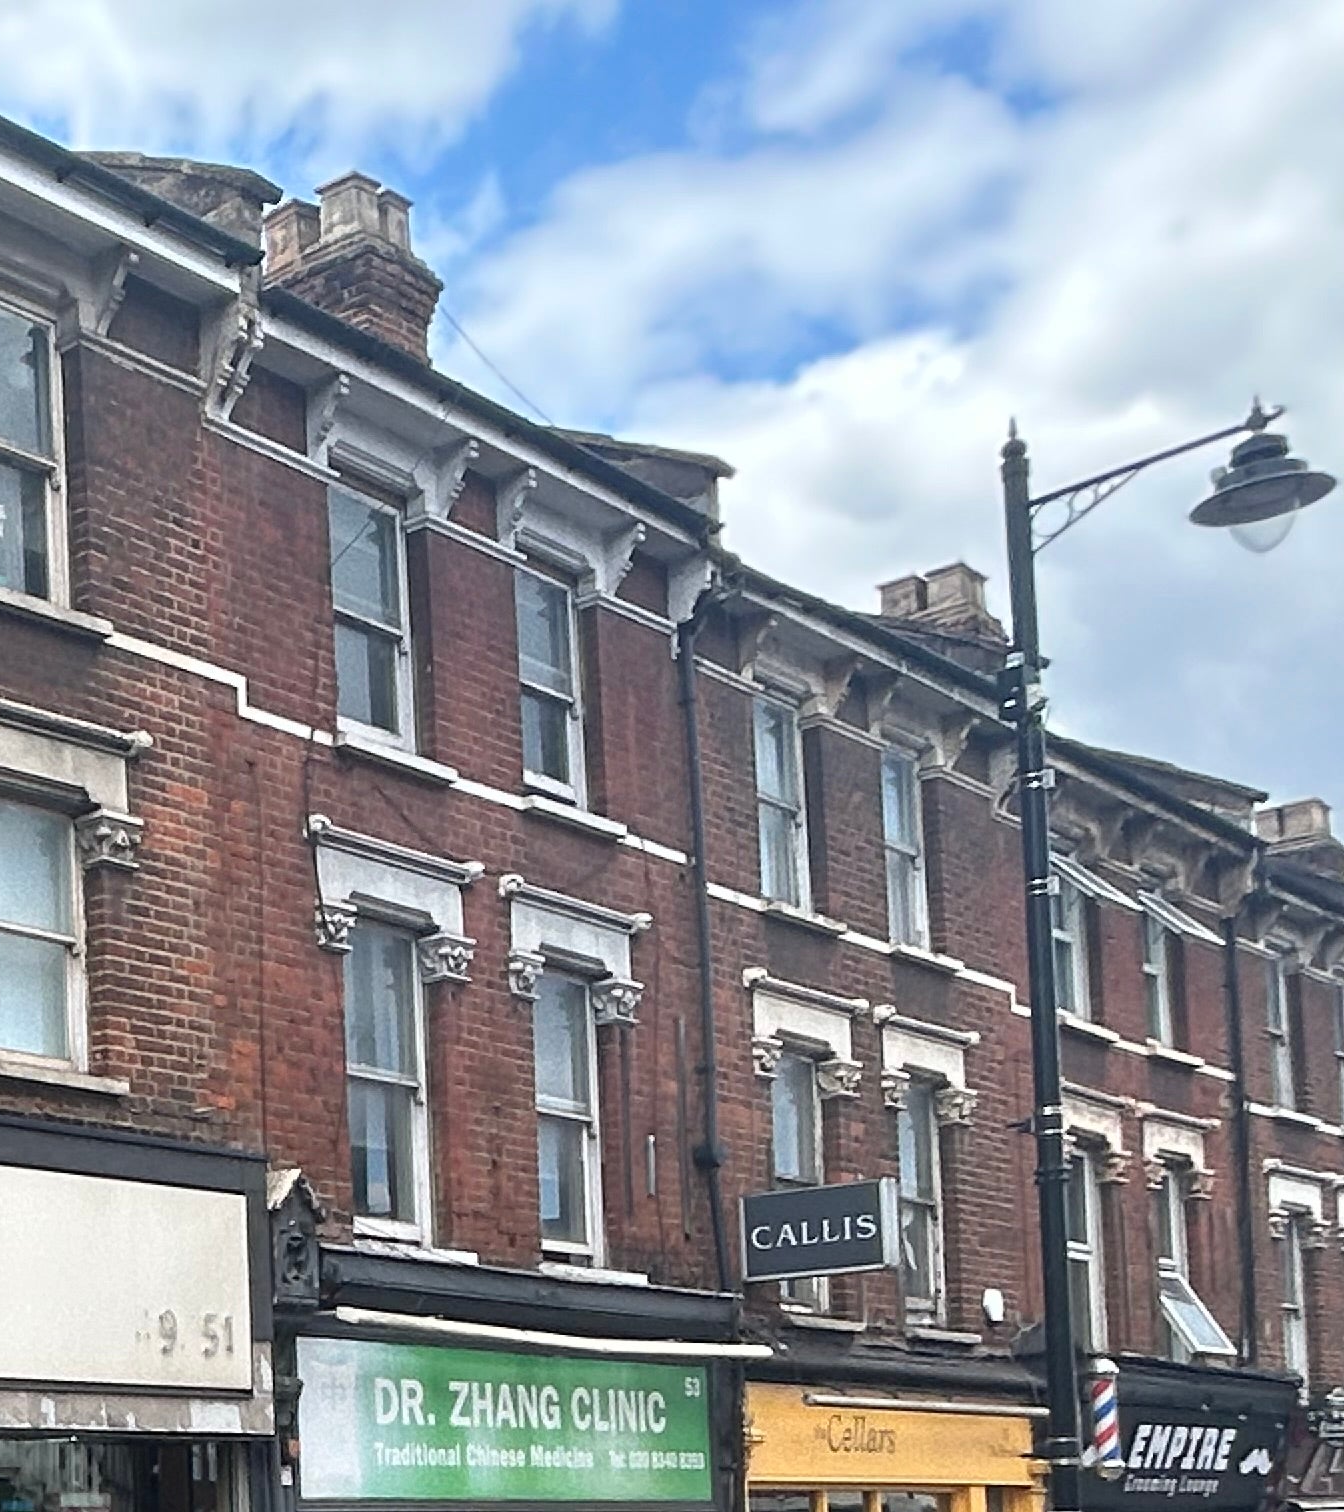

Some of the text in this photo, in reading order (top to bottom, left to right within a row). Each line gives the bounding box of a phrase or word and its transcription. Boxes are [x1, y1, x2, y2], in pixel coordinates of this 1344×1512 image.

[751, 1214, 877, 1250] CALLIS
[373, 1377, 667, 1435] DR. ZHANG CLINIC
[826, 1414, 896, 1454] Cellars
[1128, 1424, 1238, 1470] EMPIRE
[374, 1441, 461, 1467] Traditional
[466, 1444, 526, 1468] Chinese
[530, 1445, 595, 1468] Medicine
[1124, 1474, 1220, 1498] Grooming Lounge
